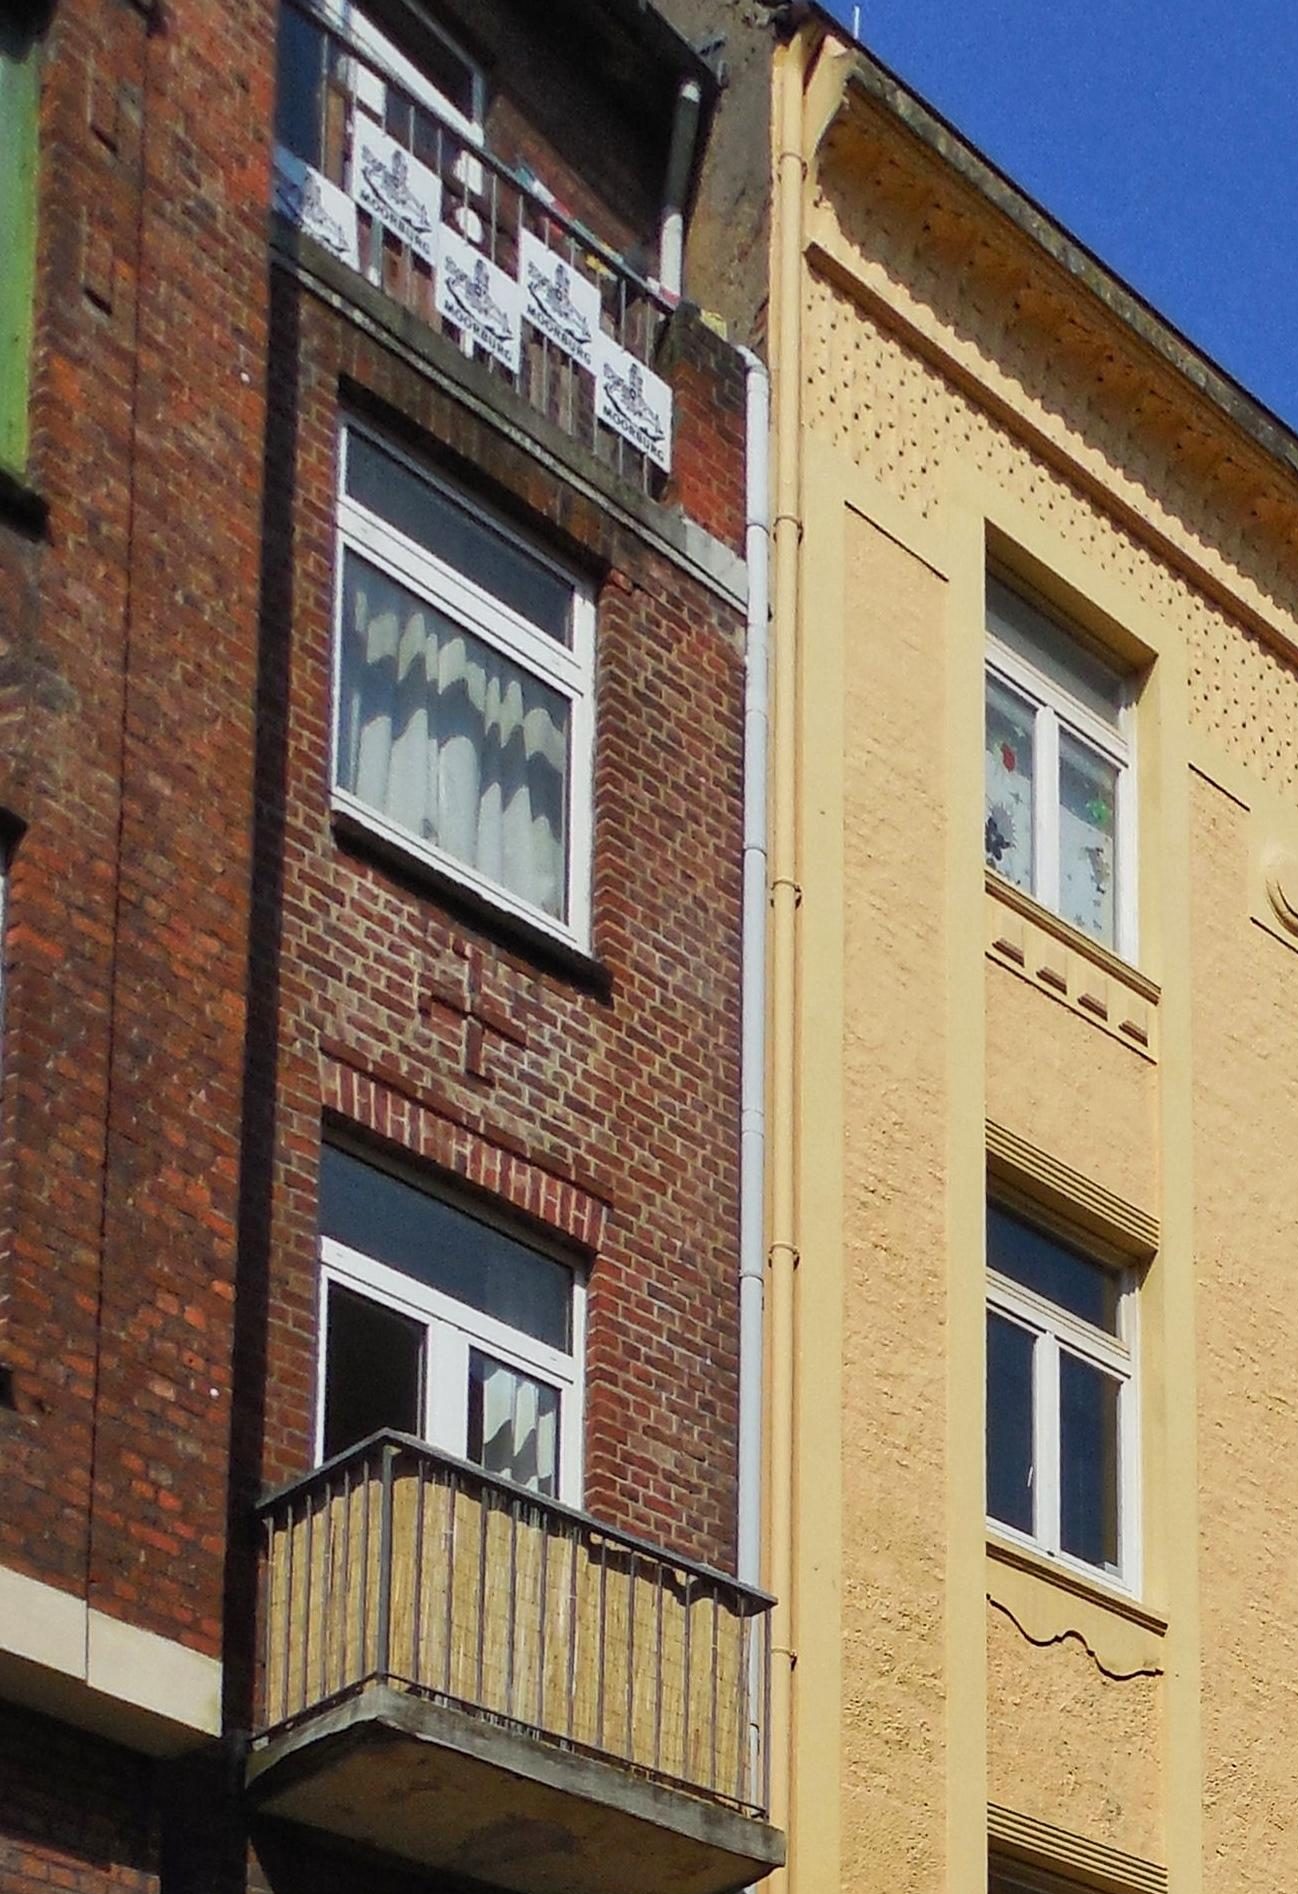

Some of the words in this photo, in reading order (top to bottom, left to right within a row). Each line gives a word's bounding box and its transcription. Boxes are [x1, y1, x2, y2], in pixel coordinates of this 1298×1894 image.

[444, 300, 513, 362] MOORBURG
[527, 304, 592, 366] MOORBURG
[603, 405, 665, 462] MOORBURG
